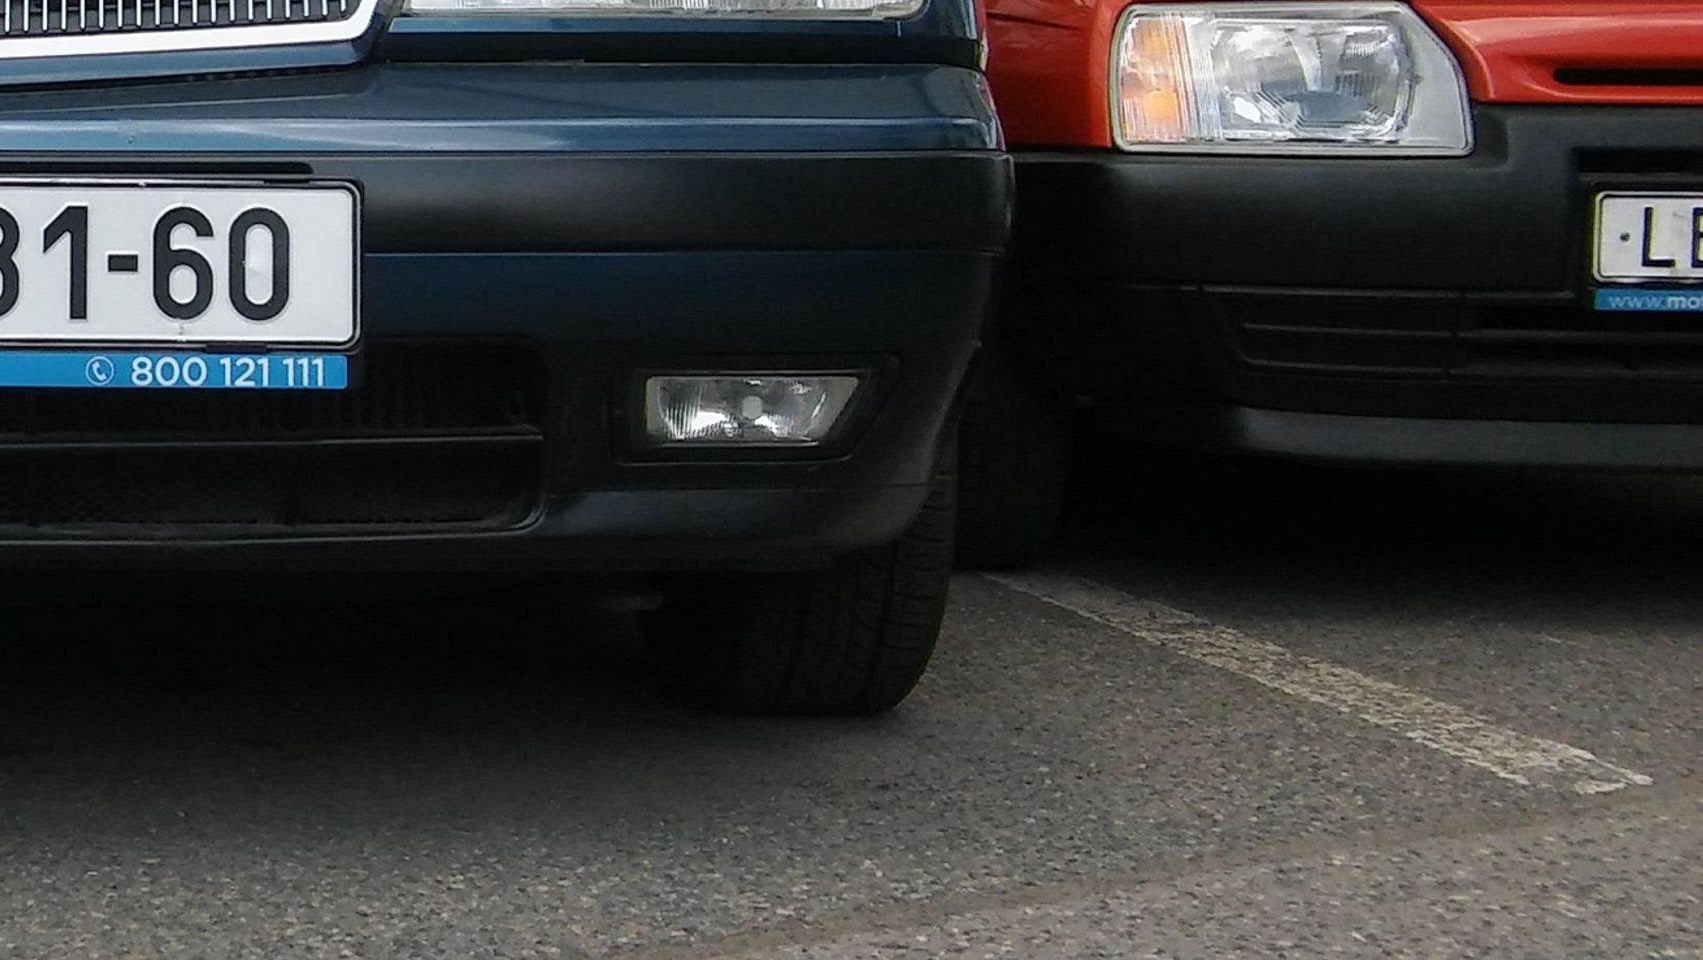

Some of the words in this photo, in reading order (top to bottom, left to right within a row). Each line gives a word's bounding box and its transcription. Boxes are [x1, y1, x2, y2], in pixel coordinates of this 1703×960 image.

[1609, 295, 1703, 309] www.mo
[131, 356, 207, 386] 800
[220, 357, 268, 387] 121
[283, 357, 324, 387] 111
